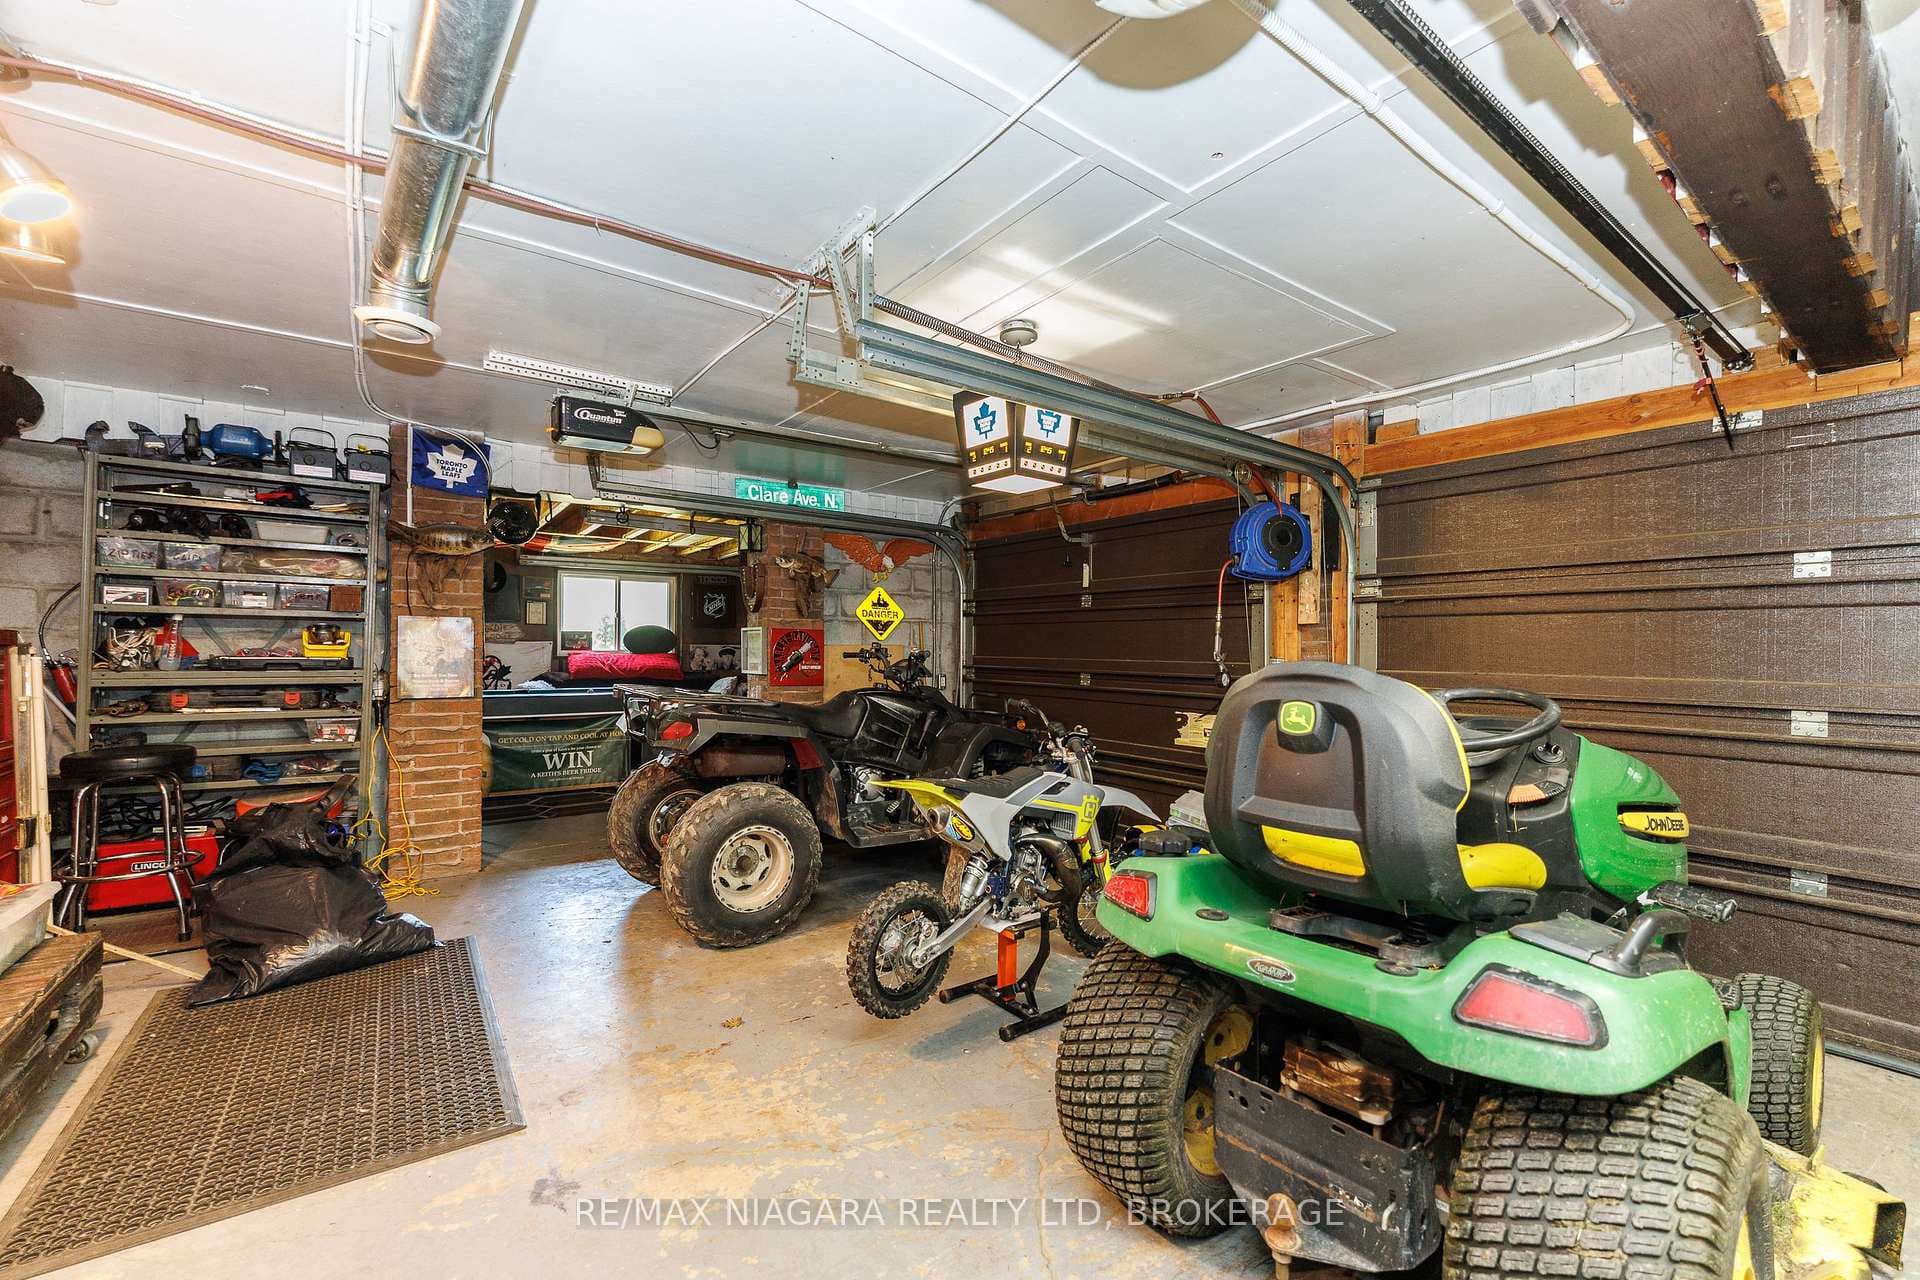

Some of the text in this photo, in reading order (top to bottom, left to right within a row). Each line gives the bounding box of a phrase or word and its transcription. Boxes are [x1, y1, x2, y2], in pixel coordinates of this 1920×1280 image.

[574, 407, 622, 424] Quantum
[436, 459, 468, 469] TORONTO
[440, 465, 463, 473] MAPLE
[442, 470, 461, 479] LEAFS
[747, 484, 838, 509] Clare Ave. N.
[862, 609, 899, 619] DANGER
[498, 736, 513, 744] GET
[536, 735, 547, 743] ON
[562, 733, 579, 741] AND
[580, 731, 598, 740] COOL
[542, 750, 594, 770] WIN
[579, 767, 602, 775] FRIDGE
[1645, 815, 1667, 831] JOHN
